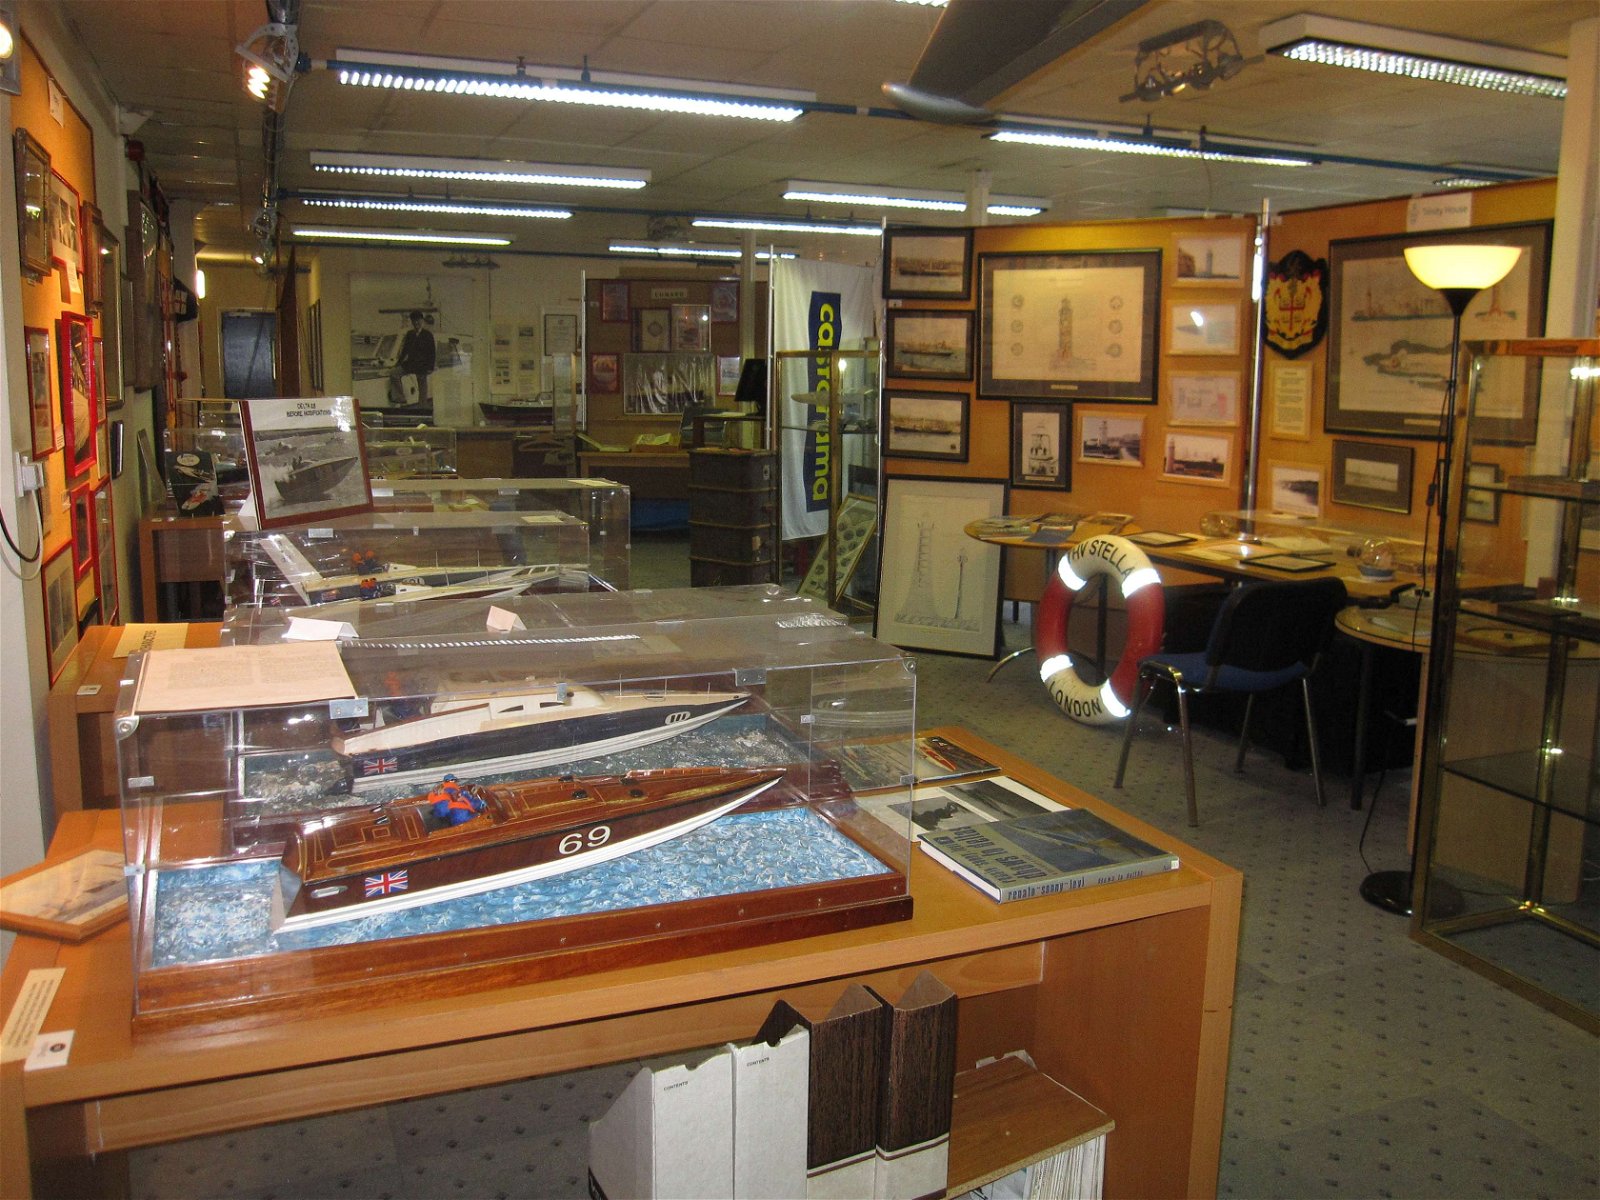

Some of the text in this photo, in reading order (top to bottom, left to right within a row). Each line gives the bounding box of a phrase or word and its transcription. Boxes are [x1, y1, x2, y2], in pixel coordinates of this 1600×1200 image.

[1444, 205, 1468, 215] House
[1089, 539, 1136, 578] STELLA
[1049, 681, 1102, 718] LONDON
[558, 825, 611, 855] 69
[1007, 886, 1035, 901] renato
[746, 1057, 770, 1067] CONTENTS
[663, 1081, 689, 1091] CONTENTS
